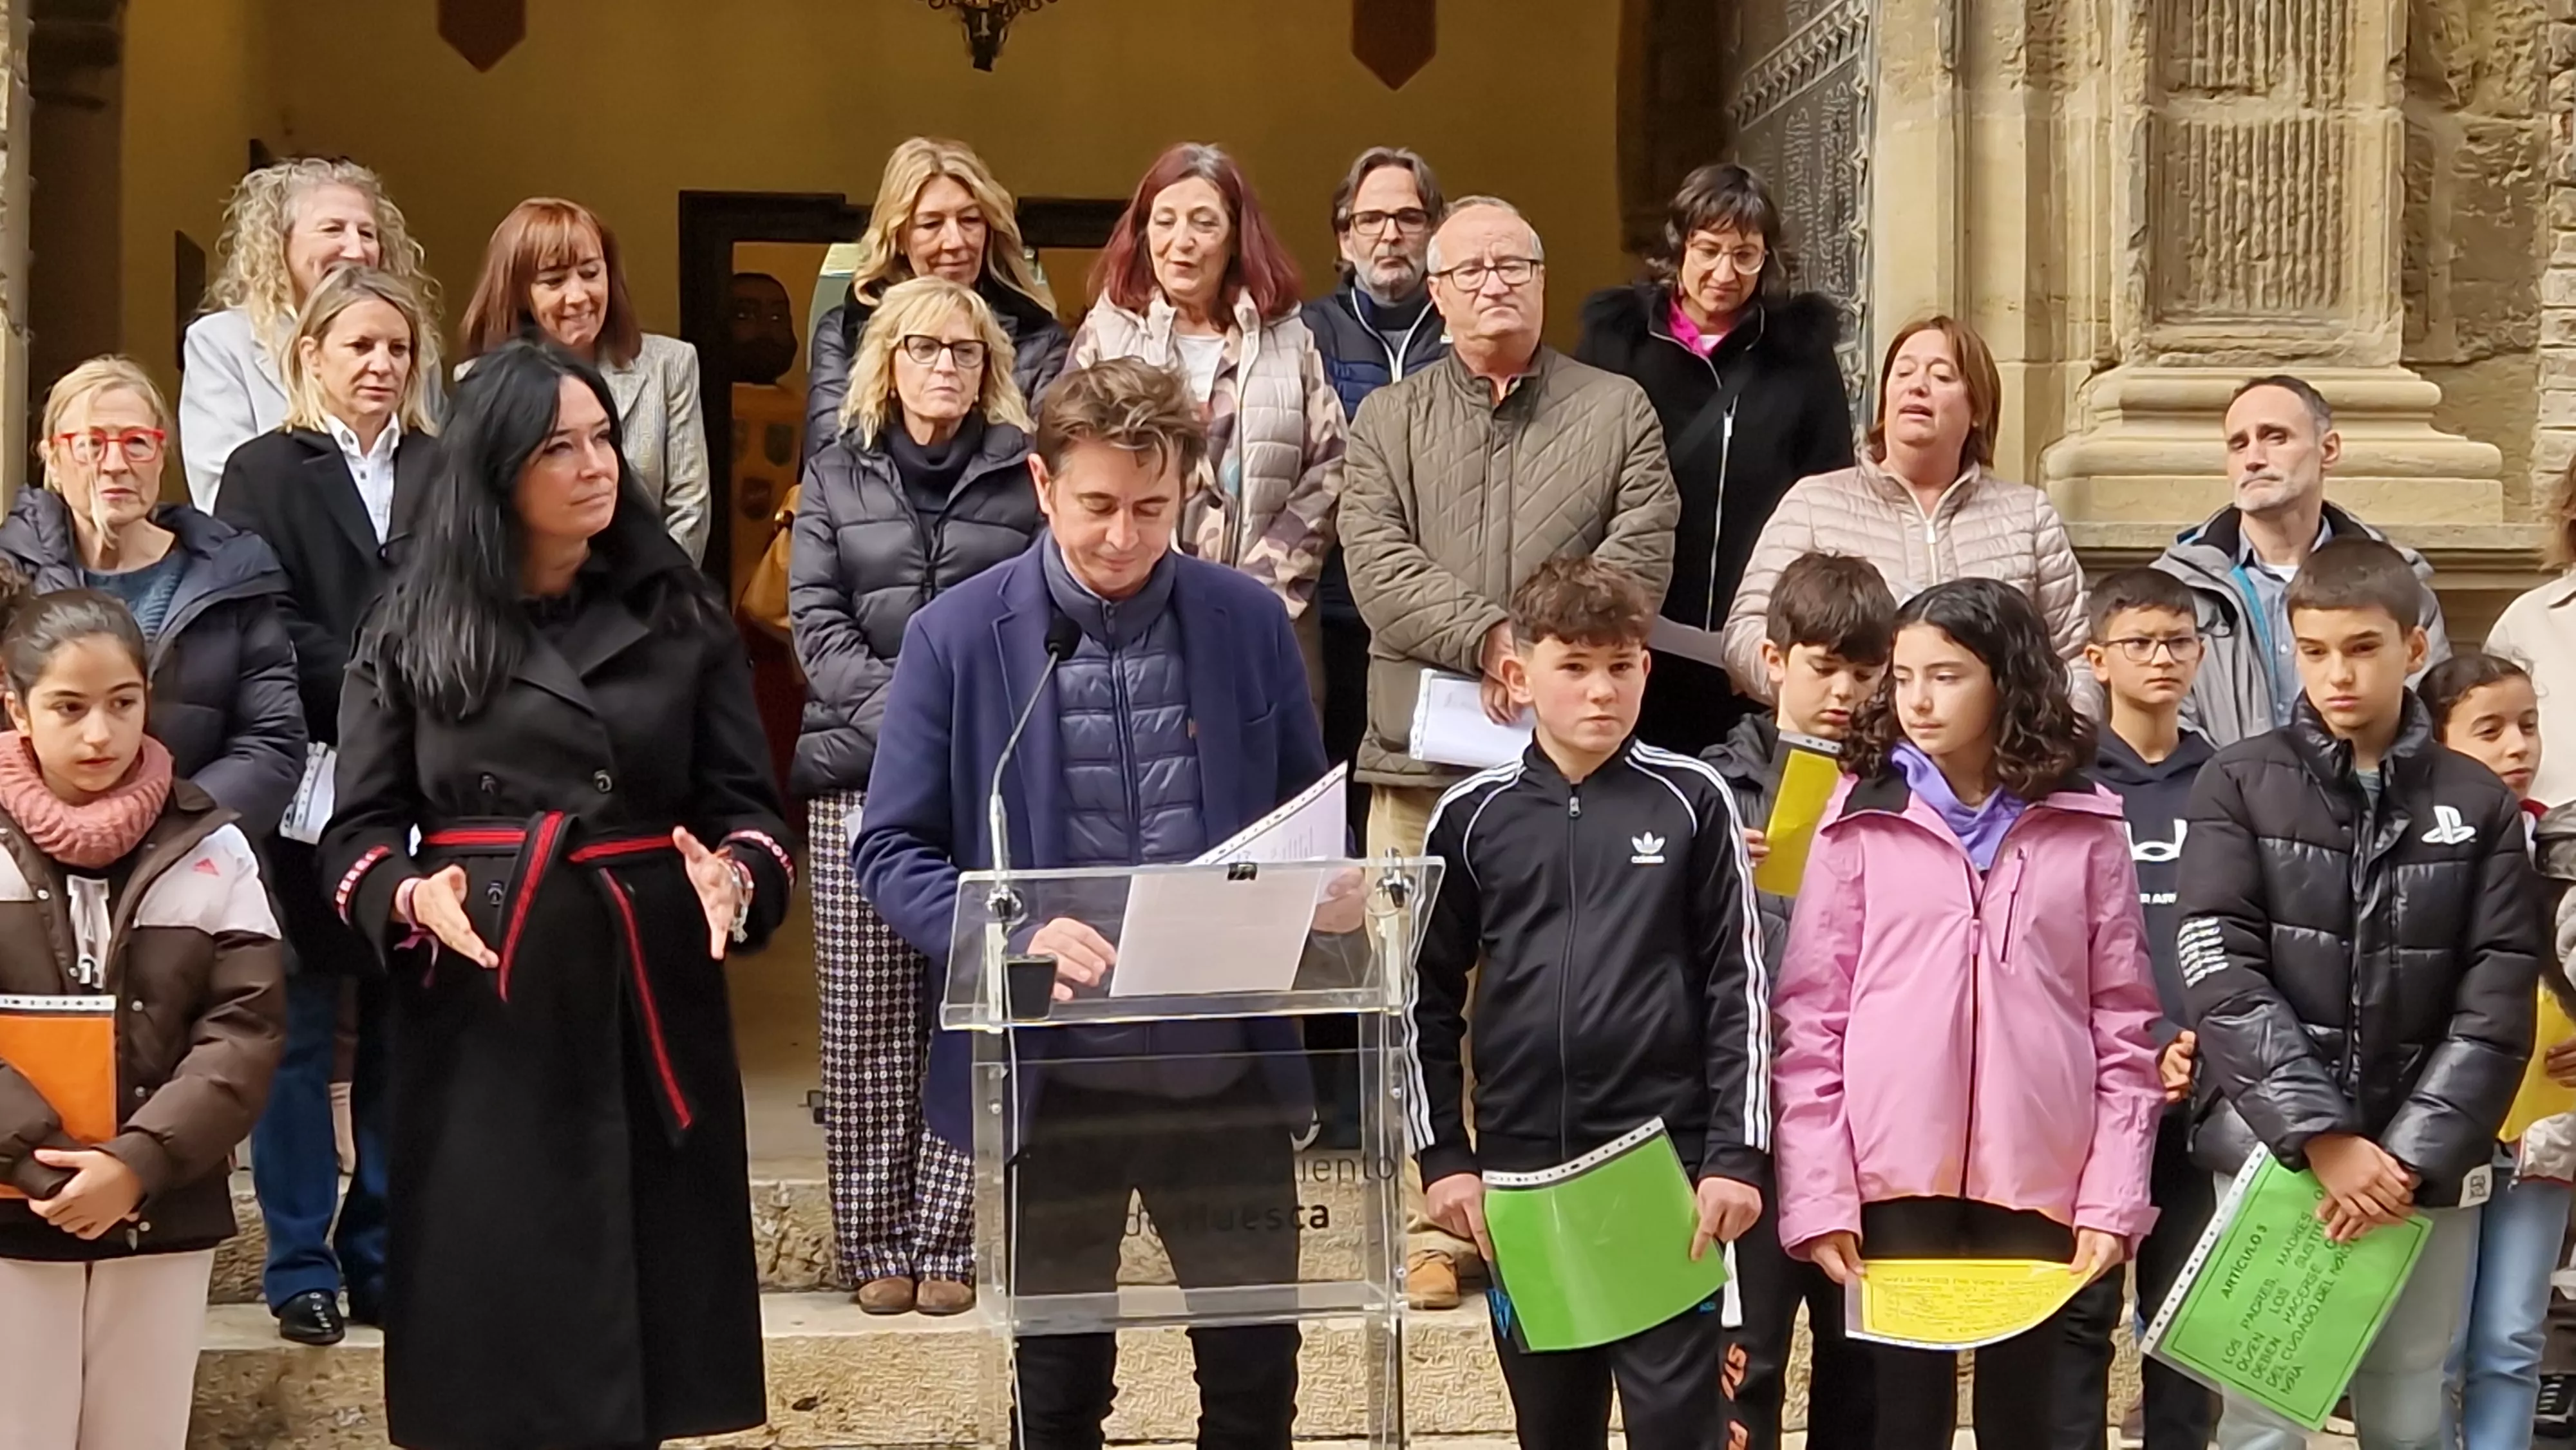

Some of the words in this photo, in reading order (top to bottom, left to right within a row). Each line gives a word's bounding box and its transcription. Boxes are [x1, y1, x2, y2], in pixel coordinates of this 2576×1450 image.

[2221, 1338, 2242, 1364] LOS
[2276, 1211, 2313, 1267] MADRES
[2250, 1337, 2282, 1379] DEBEN
[2282, 1263, 2322, 1324] HACERSE
[2265, 1365, 2287, 1388] DEL
[2280, 1304, 2320, 1361] CUIDADO
[2313, 1280, 2336, 1304] DEL
[2268, 1288, 2291, 1315] LOS
